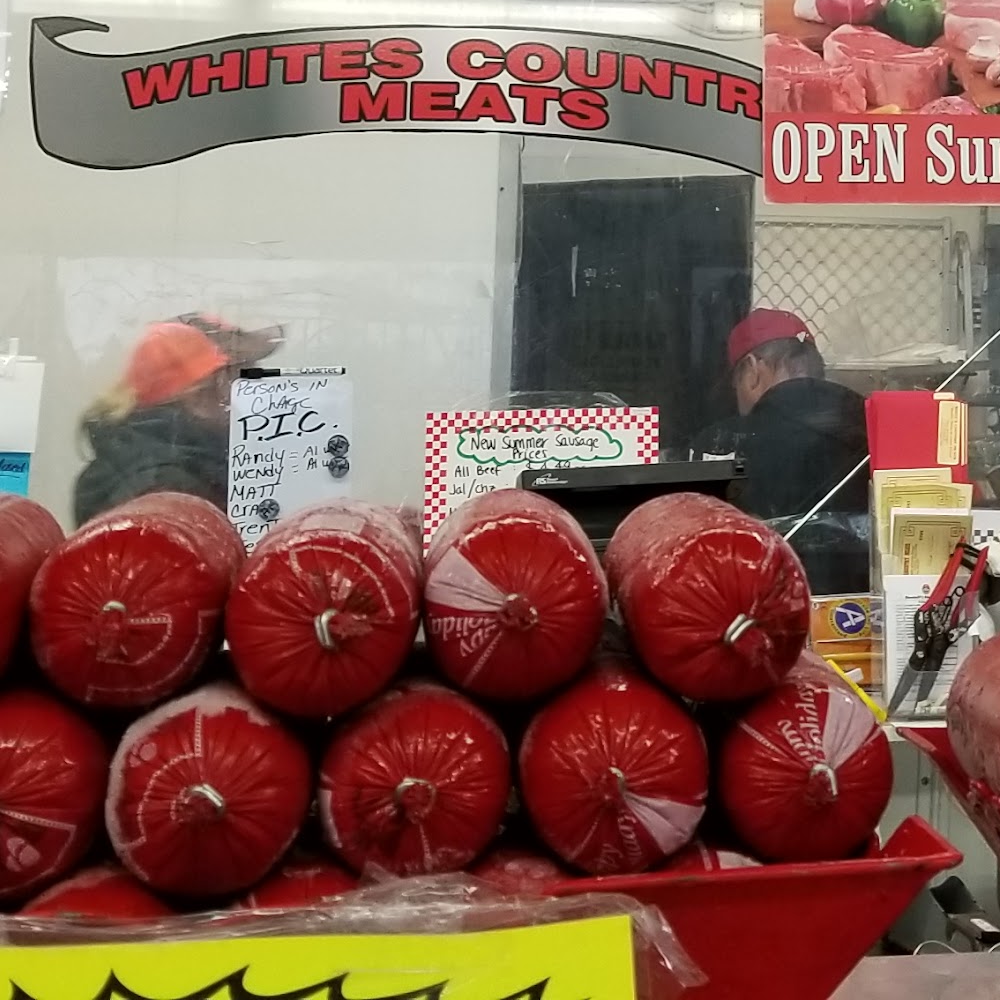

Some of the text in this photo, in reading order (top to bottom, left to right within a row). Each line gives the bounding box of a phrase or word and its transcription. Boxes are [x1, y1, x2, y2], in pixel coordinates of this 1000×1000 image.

[122, 37, 424, 110] WHITES
[339, 81, 610, 131] MEATS
[771, 120, 906, 184] OPEN
[471, 433, 600, 451] New Summer Sausage
[512, 448, 549, 460] Prices
[454, 465, 470, 477] All
[476, 464, 502, 476] Beef
